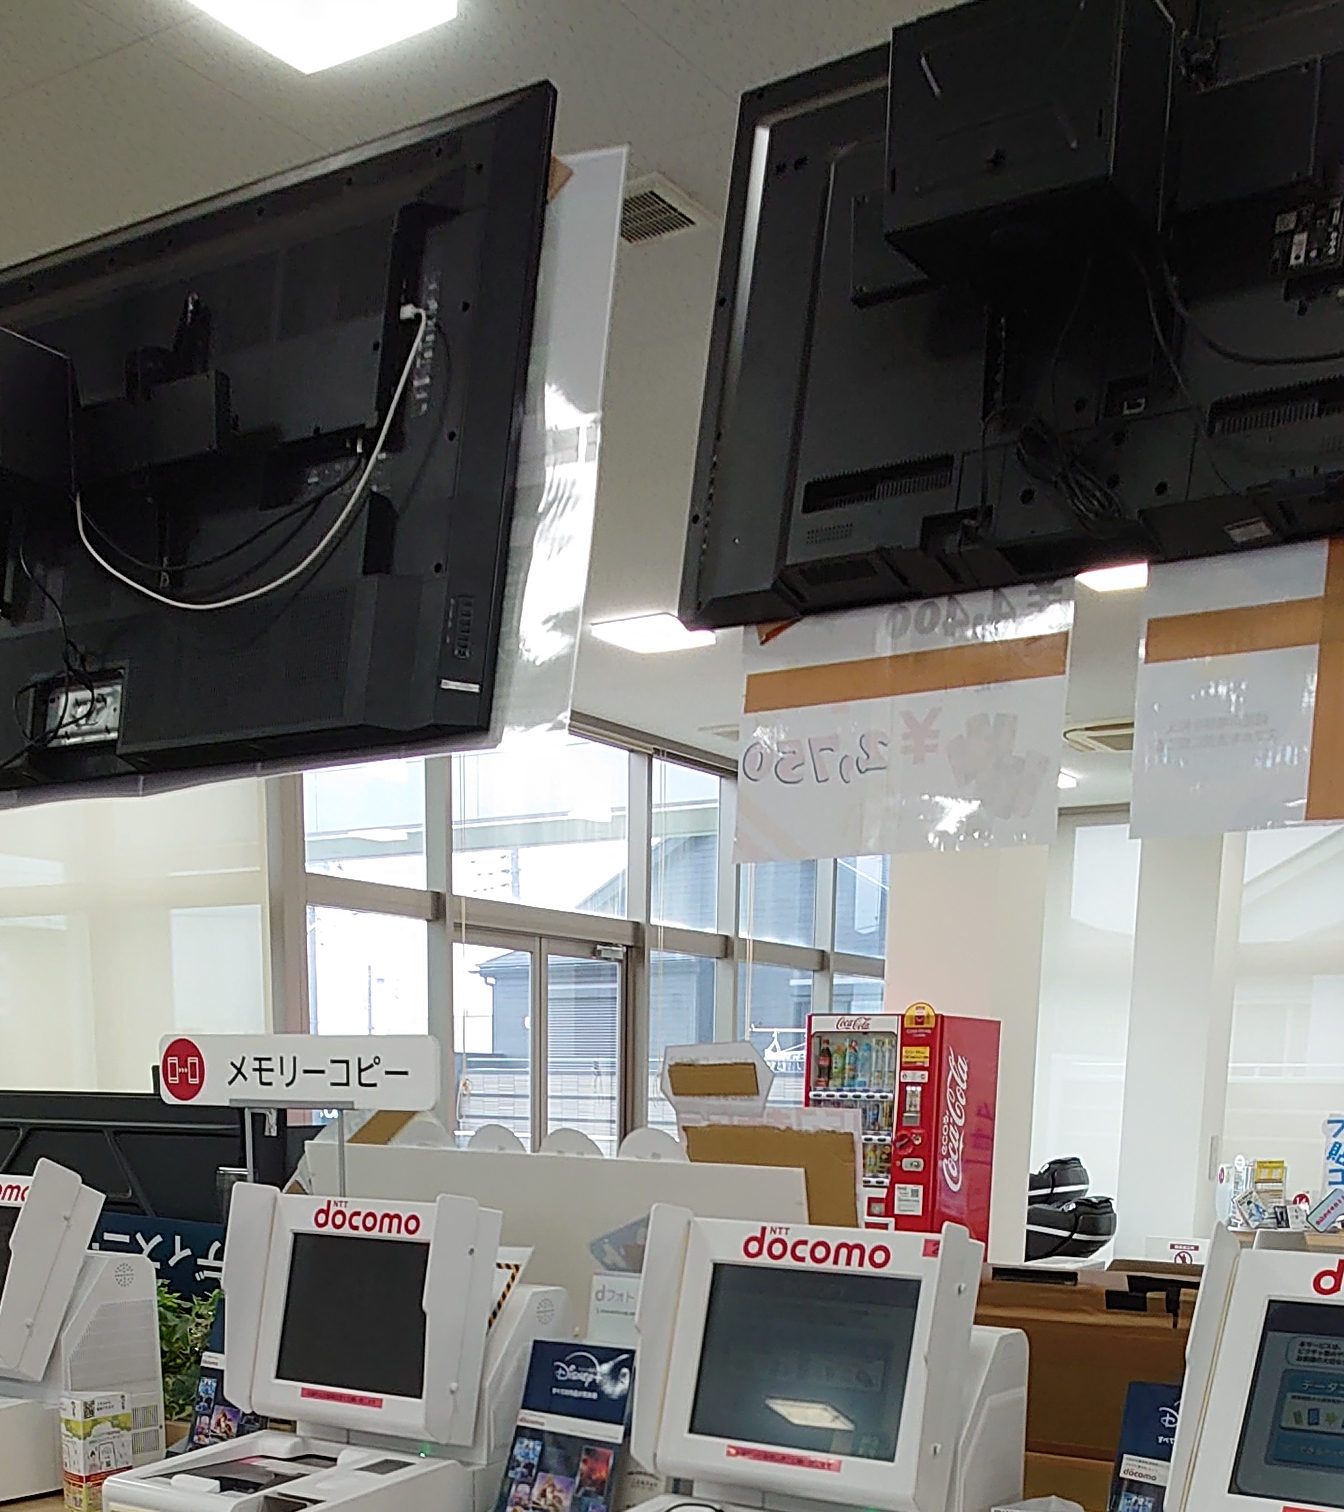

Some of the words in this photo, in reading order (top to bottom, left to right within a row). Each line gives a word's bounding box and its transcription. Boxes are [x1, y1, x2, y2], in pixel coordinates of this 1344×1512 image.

[228, 1056, 409, 1089] メモリーコピー
[333, 1201, 349, 1209] NTT
[315, 1200, 421, 1236] docomo
[770, 1226, 790, 1236] NTT
[743, 1226, 891, 1269] docomo
[1123, 1468, 1157, 1482] docomo
